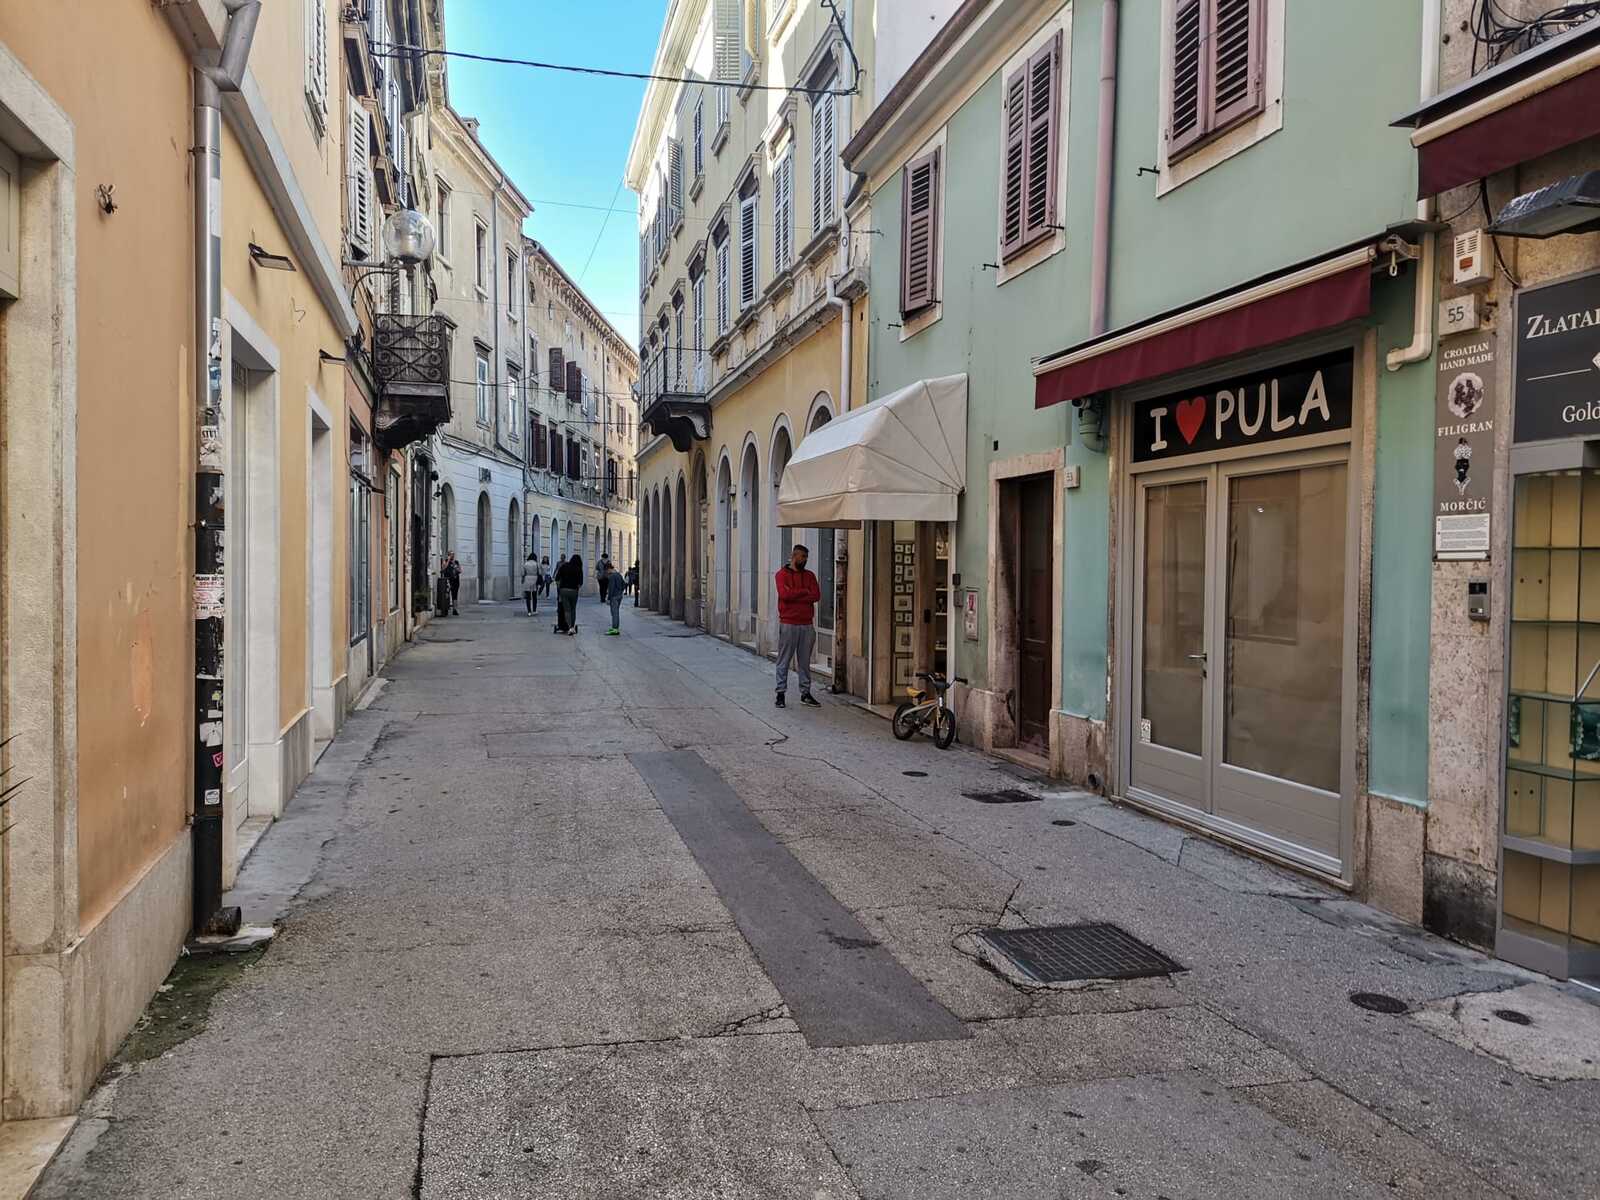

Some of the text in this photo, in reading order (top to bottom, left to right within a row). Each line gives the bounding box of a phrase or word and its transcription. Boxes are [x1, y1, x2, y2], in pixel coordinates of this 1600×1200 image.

[1447, 306, 1465, 324] 55
[1443, 341, 1489, 360] CROATIAN
[1440, 351, 1494, 371] HAND MADE
[1150, 370, 1330, 452] I PULA
[1437, 420, 1494, 437] FILIGRAN
[1440, 497, 1487, 512] MORČIĆ
